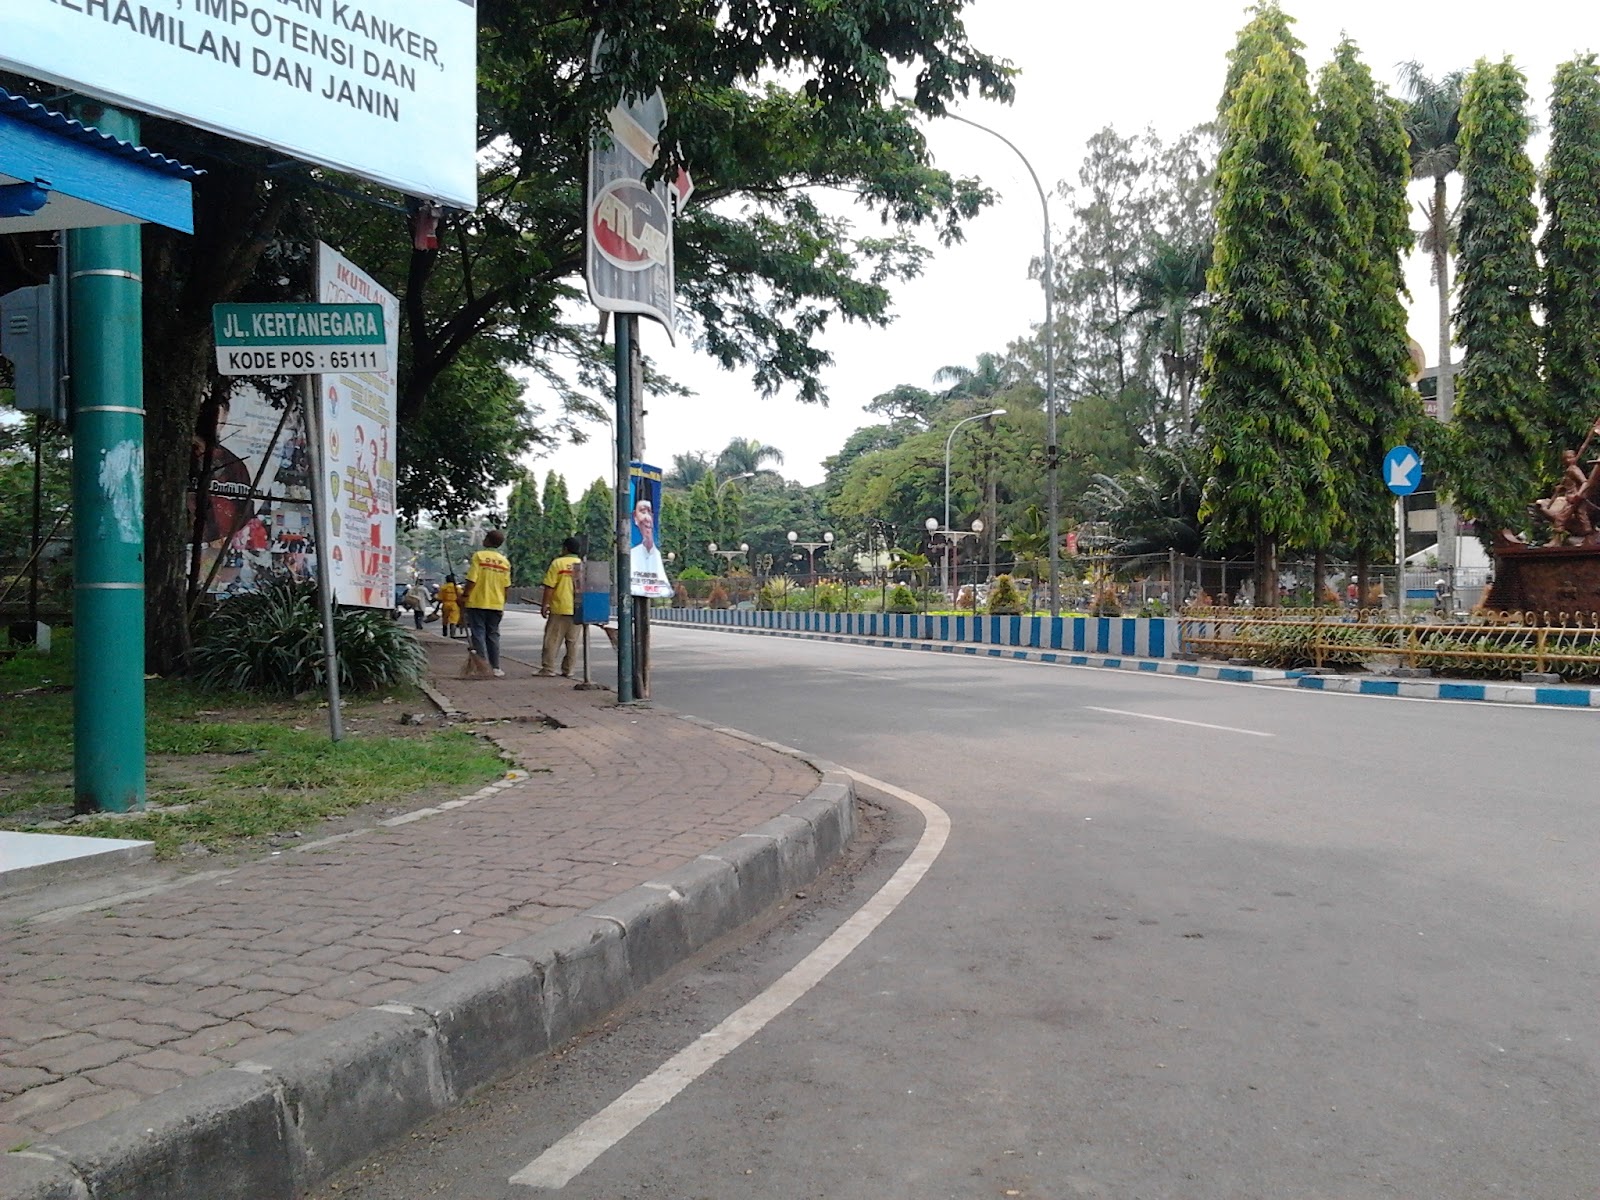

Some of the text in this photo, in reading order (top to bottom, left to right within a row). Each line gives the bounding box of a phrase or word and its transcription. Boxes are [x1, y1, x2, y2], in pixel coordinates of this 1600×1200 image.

[53, 0, 399, 122] HAMILAN DAN JANIN
[332, 0, 445, 72] KANKER,
[363, 49, 416, 93] DAN
[597, 191, 667, 266] ATLAS
[223, 312, 378, 338] JL. KERTANEGARA
[229, 351, 276, 370] KODE
[281, 351, 315, 369] POS
[330, 351, 377, 369] 65111
